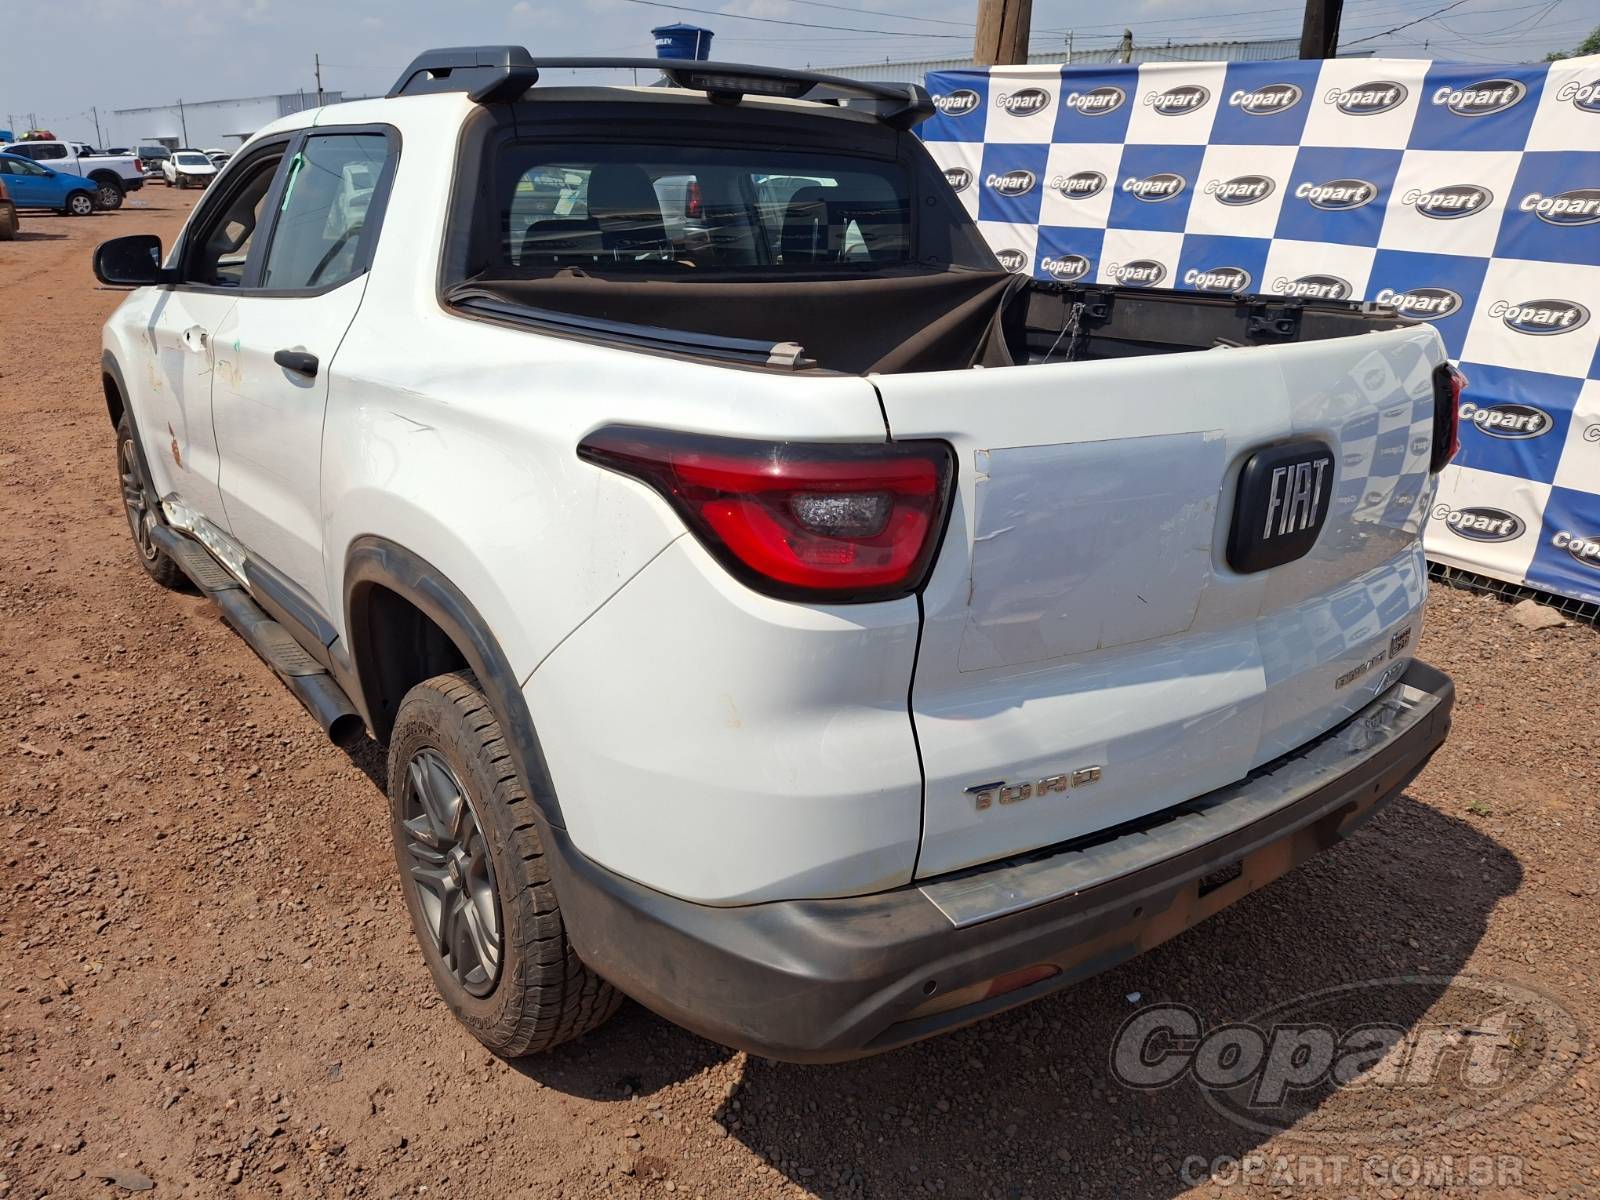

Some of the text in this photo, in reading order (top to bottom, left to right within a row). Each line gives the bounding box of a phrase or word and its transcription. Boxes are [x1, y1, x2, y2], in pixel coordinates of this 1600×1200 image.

[931, 93, 974, 109] Copart
[996, 92, 1043, 108] Copart
[1066, 91, 1118, 107] Copart
[1143, 90, 1201, 107] Copart
[1228, 90, 1291, 109] Copart
[1324, 87, 1400, 109] Copart
[1432, 86, 1516, 109] Copart
[1556, 81, 1600, 105] Cop
[985, 174, 1030, 191] Copart
[1051, 175, 1098, 191] Copart
[1122, 176, 1178, 194] Copart
[1204, 179, 1267, 197] Copart
[1296, 181, 1369, 202] Copart
[1402, 188, 1485, 209] Copart
[1041, 256, 1084, 276] Copart
[1107, 262, 1159, 282] Copart
[1184, 269, 1244, 290] Copart
[1272, 276, 1344, 298] Copart
[1376, 288, 1452, 312] Copart
[1487, 300, 1576, 327] Copart
[1458, 401, 1544, 431] Copart
[1263, 458, 1329, 540] FIAT
[1430, 503, 1514, 536] Copart
[963, 764, 1102, 811] TORO
